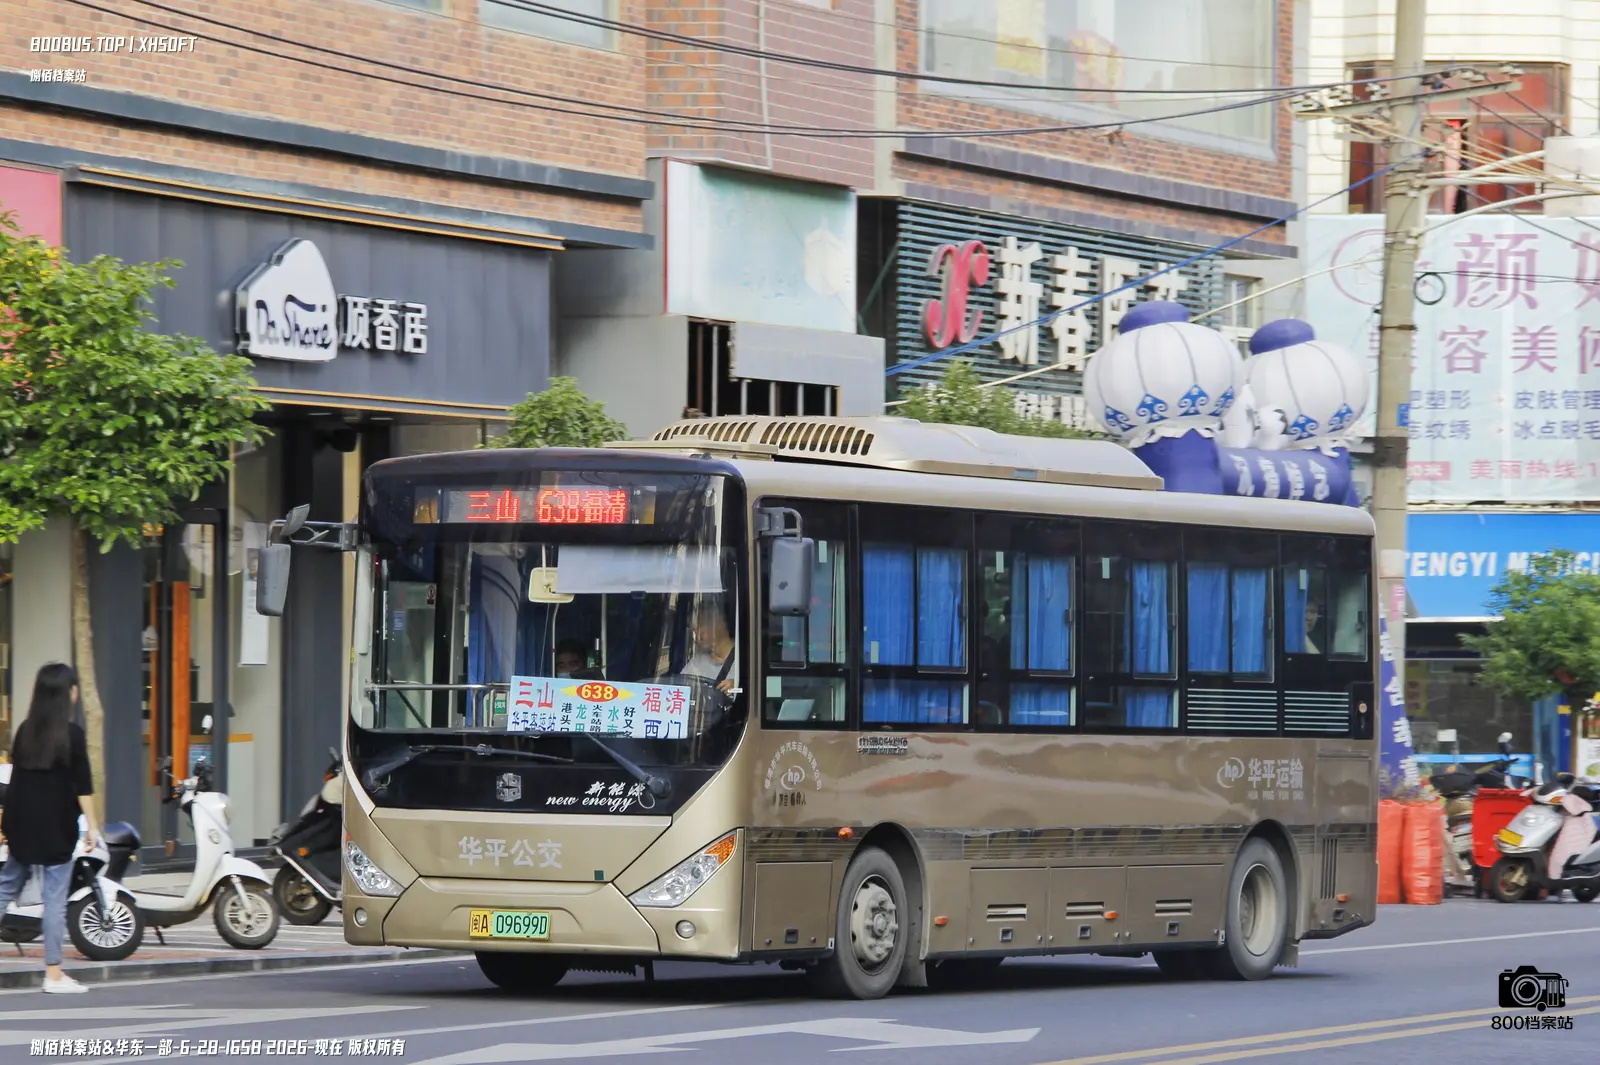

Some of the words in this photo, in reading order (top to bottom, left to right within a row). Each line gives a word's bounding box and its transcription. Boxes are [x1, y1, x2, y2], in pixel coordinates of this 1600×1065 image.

[343, 295, 429, 354] 顶香居
[467, 488, 520, 522] 三山
[1405, 551, 1498, 577] ENGYI
[515, 681, 555, 709] 三山
[581, 684, 614, 700] 638
[642, 686, 686, 716] 福清
[1247, 758, 1304, 789] 华平运输
[584, 780, 646, 798] 新能源
[545, 795, 579, 807] new
[582, 795, 637, 813] energy
[457, 835, 563, 870] 华平公交
[496, 914, 548, 936] 09699D
